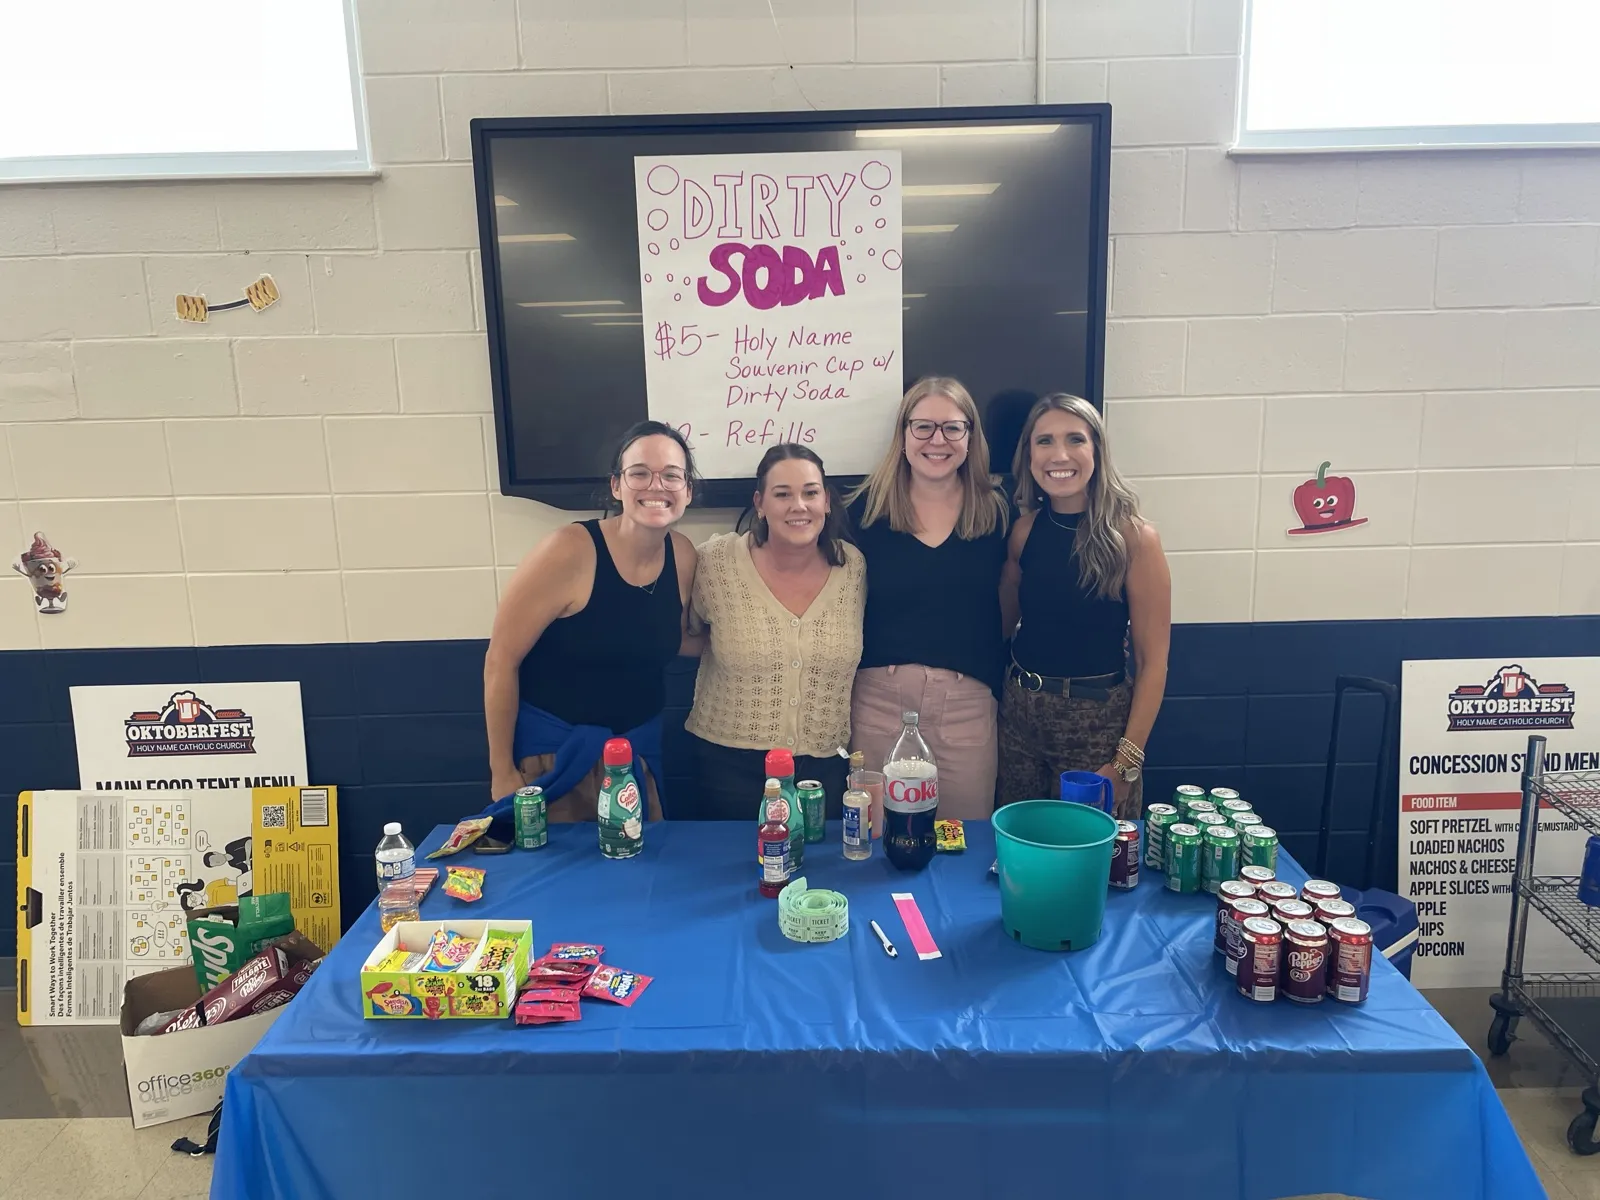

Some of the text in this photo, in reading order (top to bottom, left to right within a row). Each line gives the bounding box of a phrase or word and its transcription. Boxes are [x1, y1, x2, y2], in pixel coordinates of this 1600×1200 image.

[683, 171, 856, 240] DIRTY
[697, 242, 846, 310] SODA
[734, 324, 778, 360] Holy
[788, 326, 852, 348] Name
[725, 350, 894, 380] Souvenir Cup w/
[726, 380, 850, 412] Dirty Soda
[726, 419, 816, 447] Refills
[1450, 698, 1572, 714] OKTOBERFEST
[1456, 717, 1565, 726] HOLY NAME CATHOLIC CHURCH
[127, 723, 251, 740] OKTOBERFEST
[136, 742, 246, 752] HOLY NAME CATHOLIC CHURCH
[1409, 753, 1508, 775] CONCESSION
[1511, 752, 1561, 773] STND
[889, 780, 938, 803] Coke
[1411, 796, 1457, 809] FOOD ITEM
[1410, 819, 1439, 834] SOFT
[1442, 818, 1492, 833] PRETZEL
[1494, 823, 1514, 832] WITH
[1145, 813, 1165, 870] Sprite
[1410, 838, 1505, 855] LOADED NACHOS
[57, 852, 65, 887] ensemble
[1410, 858, 1516, 875] NACHOS & CHEESE
[1409, 879, 1511, 896] APPLE SLICES WITH
[1415, 901, 1447, 916] PPLE
[49, 912, 57, 944] Together
[57, 921, 64, 931] de
[66, 907, 74, 935] Trabajar
[1418, 922, 1444, 936] HIPS
[66, 937, 73, 946] de
[1416, 942, 1465, 957] OPCORN
[57, 932, 66, 977] intelligentes
[1288, 952, 1322, 969] Pepper
[1300, 951, 1314, 961] Dr
[49, 966, 56, 974] to
[66, 947, 74, 990] Inteligentes
[233, 960, 268, 987] TAILGATE
[49, 974, 57, 994] Ways
[57, 977, 66, 1002] façons
[475, 976, 493, 988] 18
